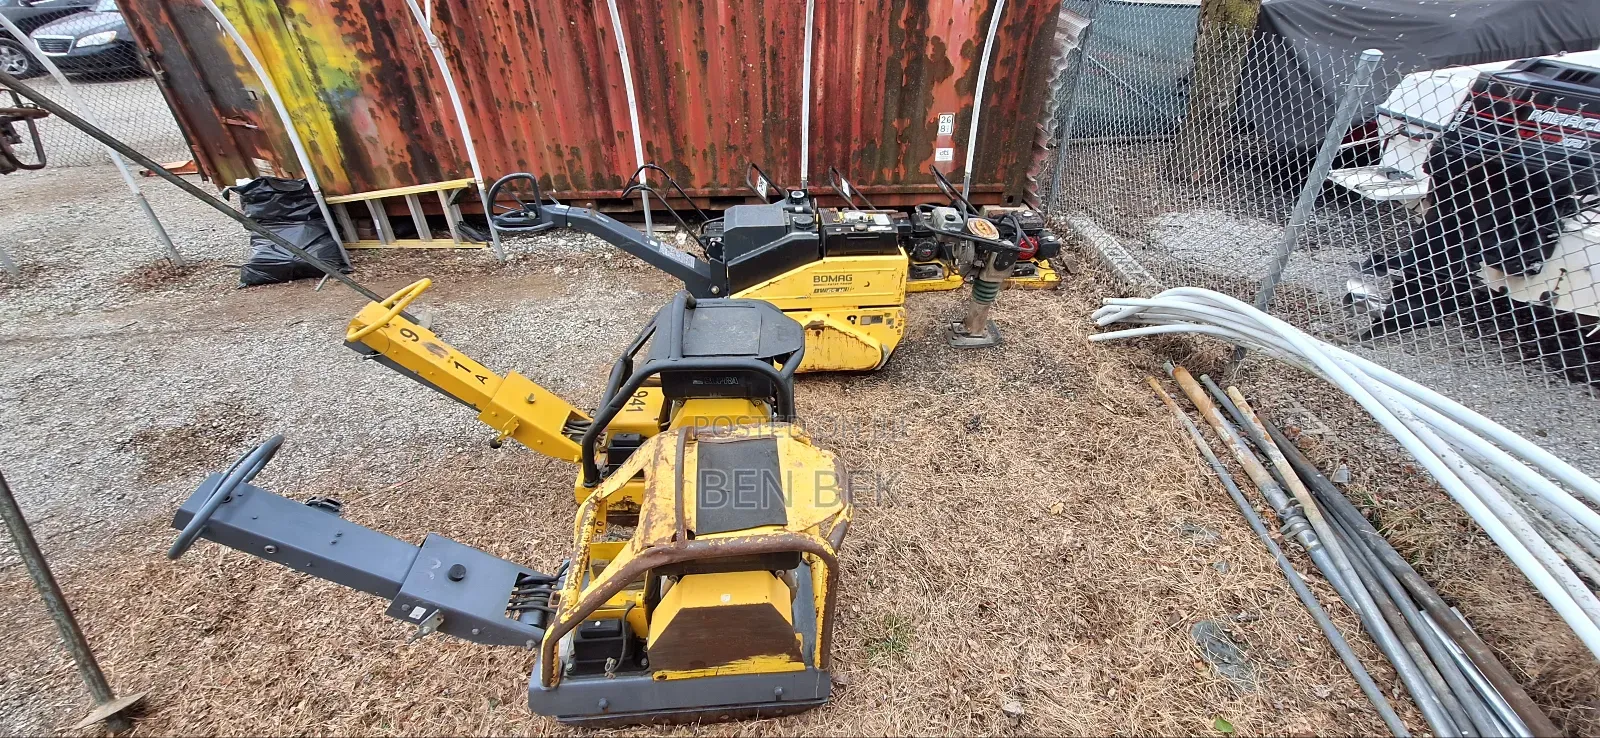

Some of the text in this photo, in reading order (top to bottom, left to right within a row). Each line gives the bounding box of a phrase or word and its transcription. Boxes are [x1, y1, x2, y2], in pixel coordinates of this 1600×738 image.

[813, 274, 853, 283] BOMAG
[399, 328, 419, 342] 9
[475, 374, 488, 385] A
